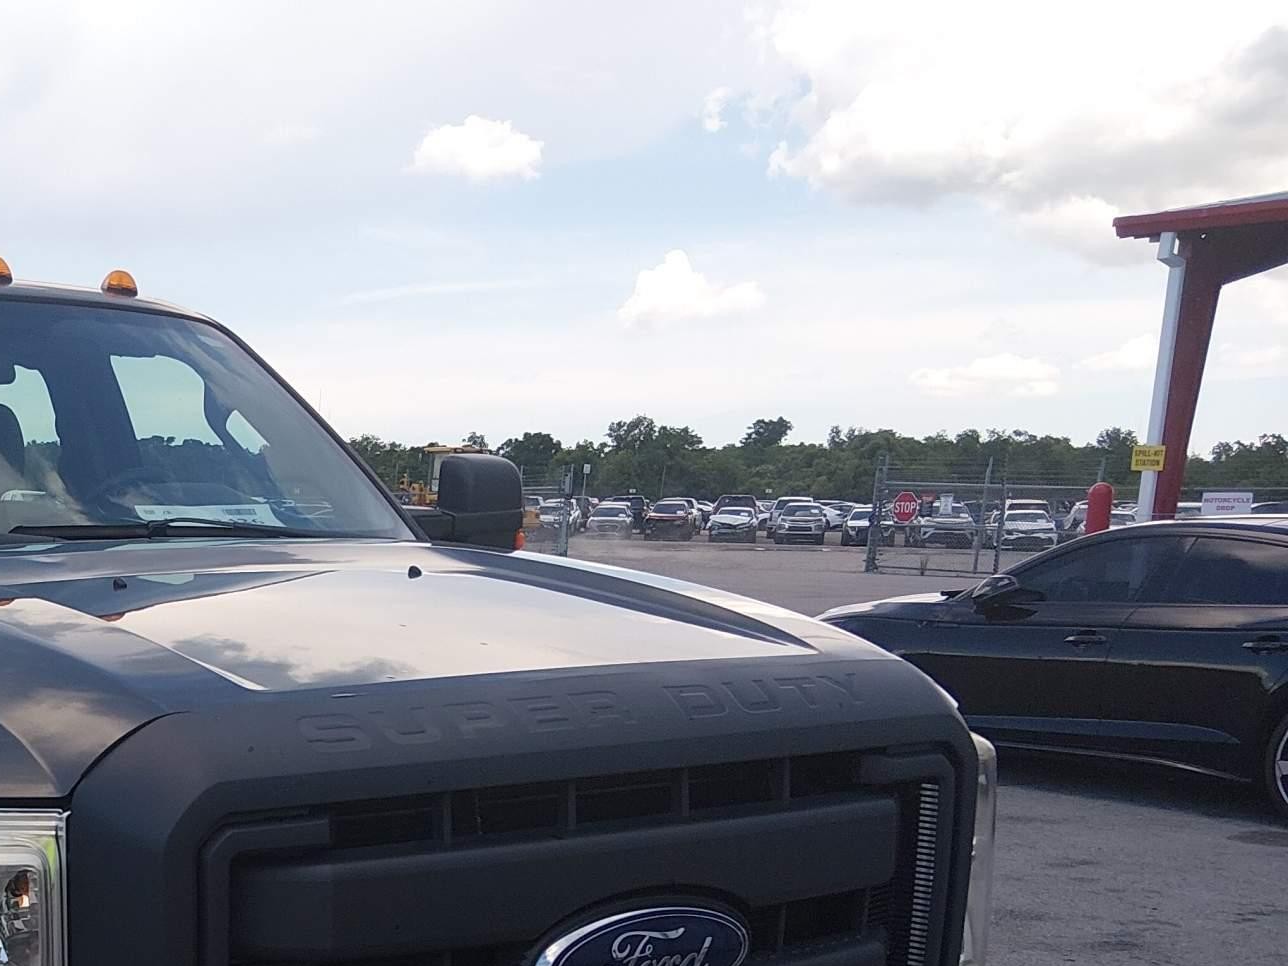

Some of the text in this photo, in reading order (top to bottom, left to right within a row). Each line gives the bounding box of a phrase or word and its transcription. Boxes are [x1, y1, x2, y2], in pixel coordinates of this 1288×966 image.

[894, 501, 917, 513] STOP
[294, 671, 866, 754] SUPER DUTY
